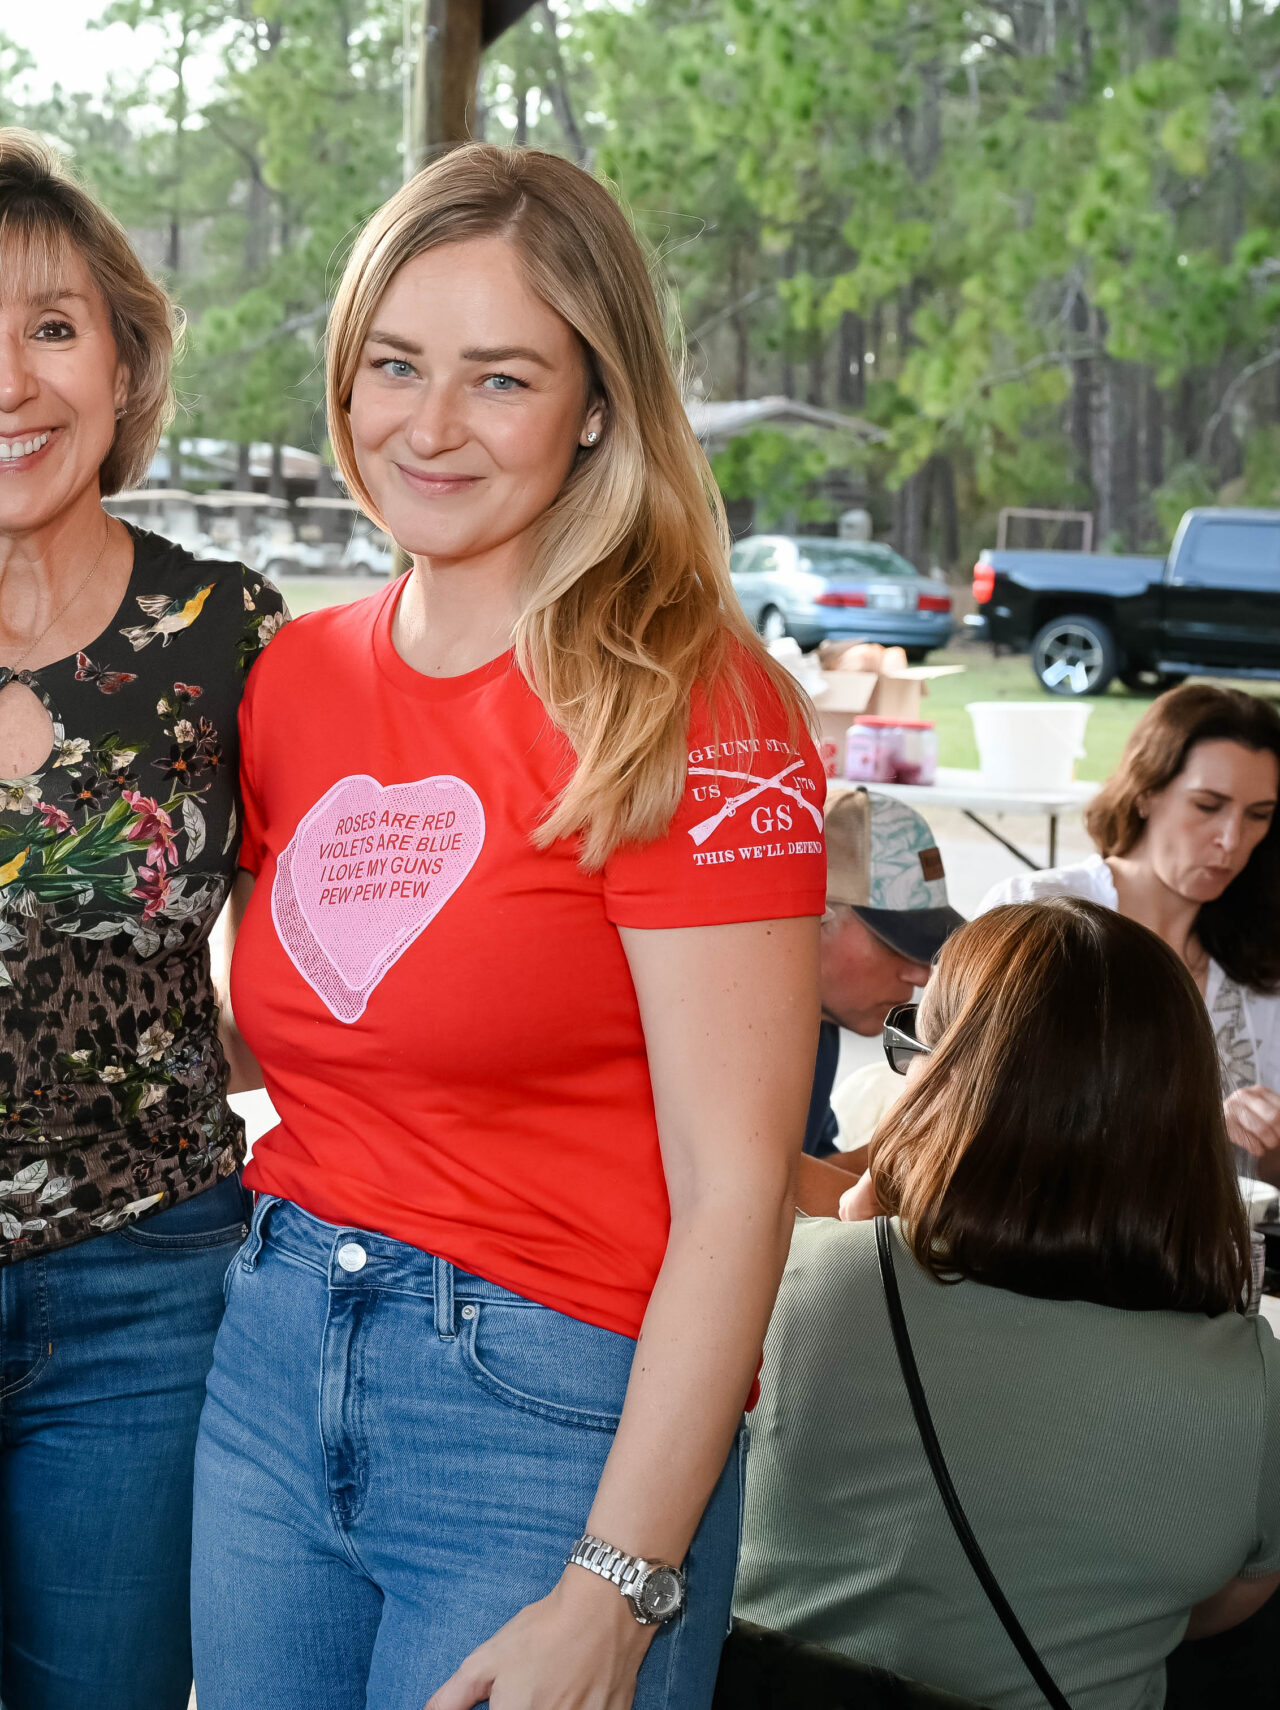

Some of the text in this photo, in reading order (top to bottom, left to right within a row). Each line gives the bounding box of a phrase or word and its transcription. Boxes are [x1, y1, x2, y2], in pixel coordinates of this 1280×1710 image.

[688, 738, 760, 764] GRUNT
[691, 784, 721, 802] US
[792, 776, 816, 791] 1776
[335, 809, 456, 836] ROSES ARE RED
[750, 804, 793, 834] GS
[319, 832, 463, 860] VIOLETS ARE BLUE
[693, 841, 823, 866] THIS WE'LL DEFEND
[320, 856, 444, 883] I LOVE MY GUNS
[319, 880, 431, 906] PEW PEW PEW
